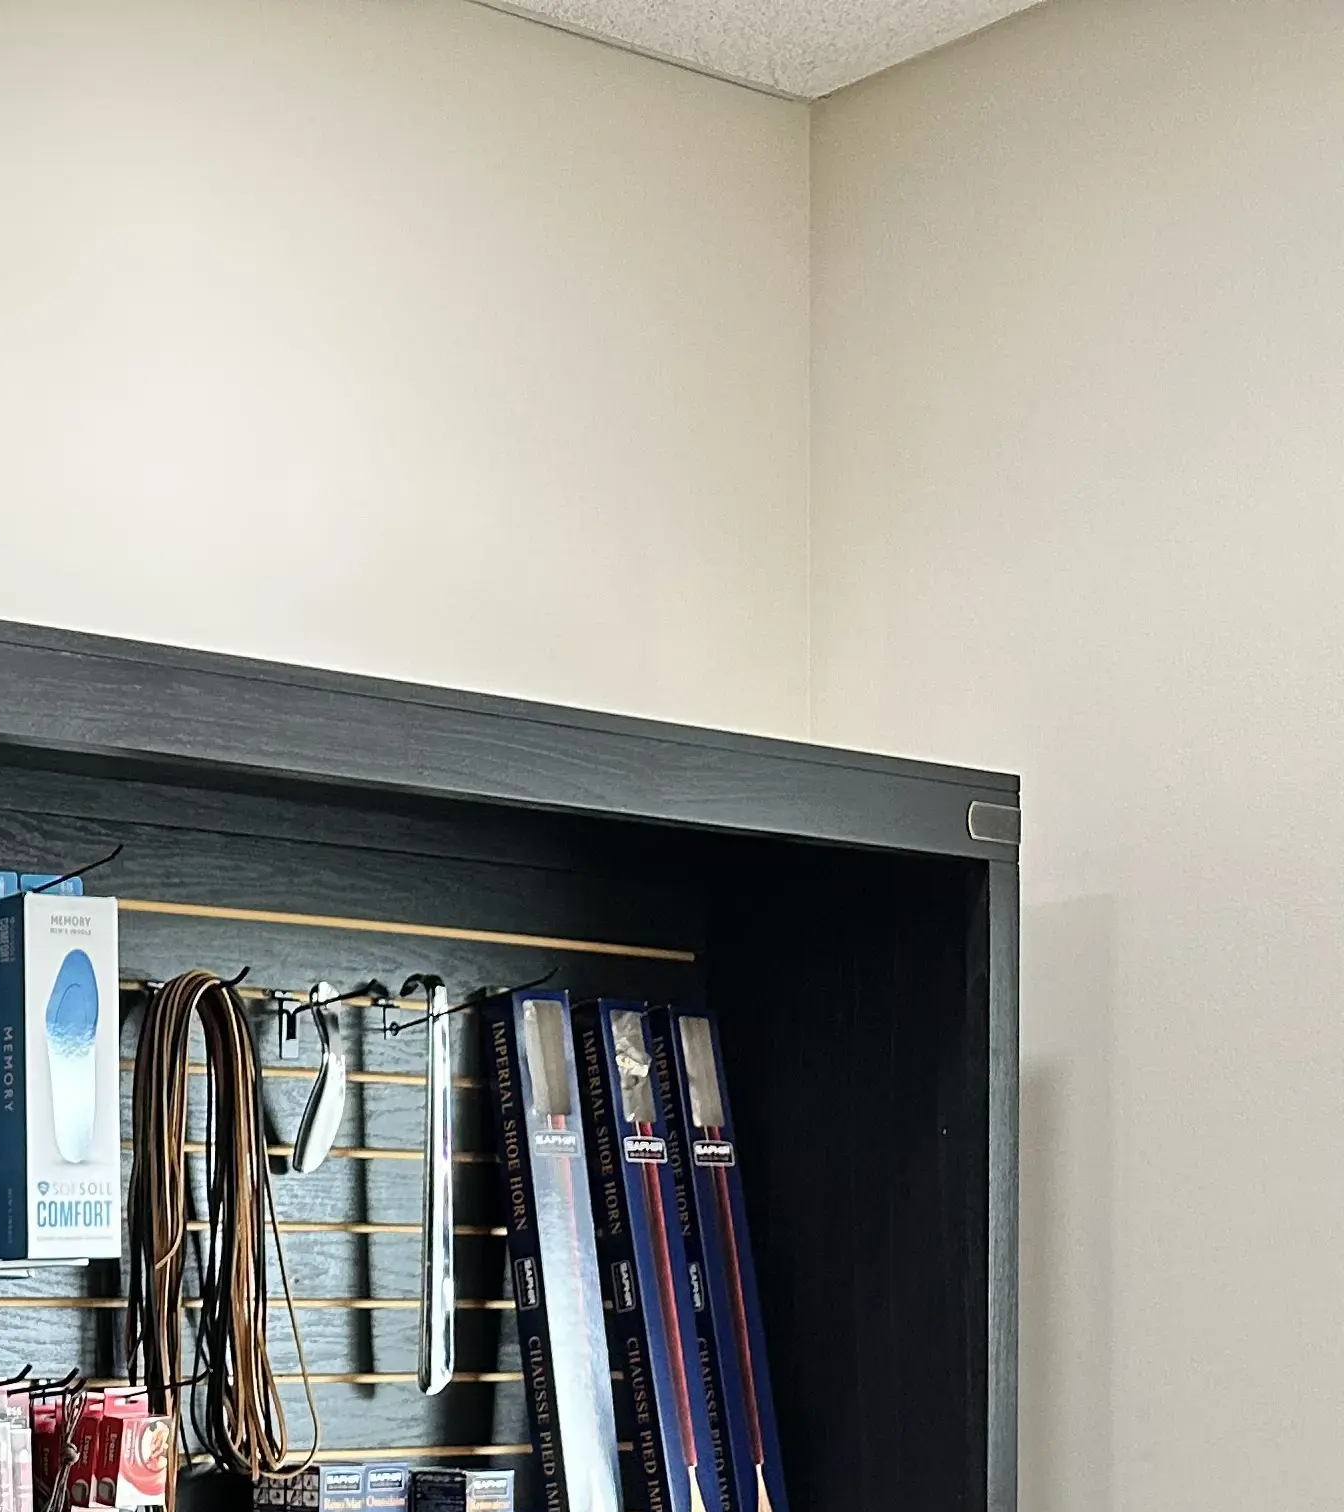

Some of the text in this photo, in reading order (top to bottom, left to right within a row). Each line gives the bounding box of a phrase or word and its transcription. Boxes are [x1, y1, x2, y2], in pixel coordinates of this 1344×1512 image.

[50, 916, 91, 926] MEMORY
[4, 1027, 14, 1111] MEMORY
[492, 1021, 528, 1231] IMPERIAL SHOE HORN
[583, 1030, 623, 1235] IMPERIAL SHOE HORN
[37, 1200, 112, 1228] COMFORT
[540, 1431, 555, 1476] PIED
[640, 1430, 656, 1474] PIED
